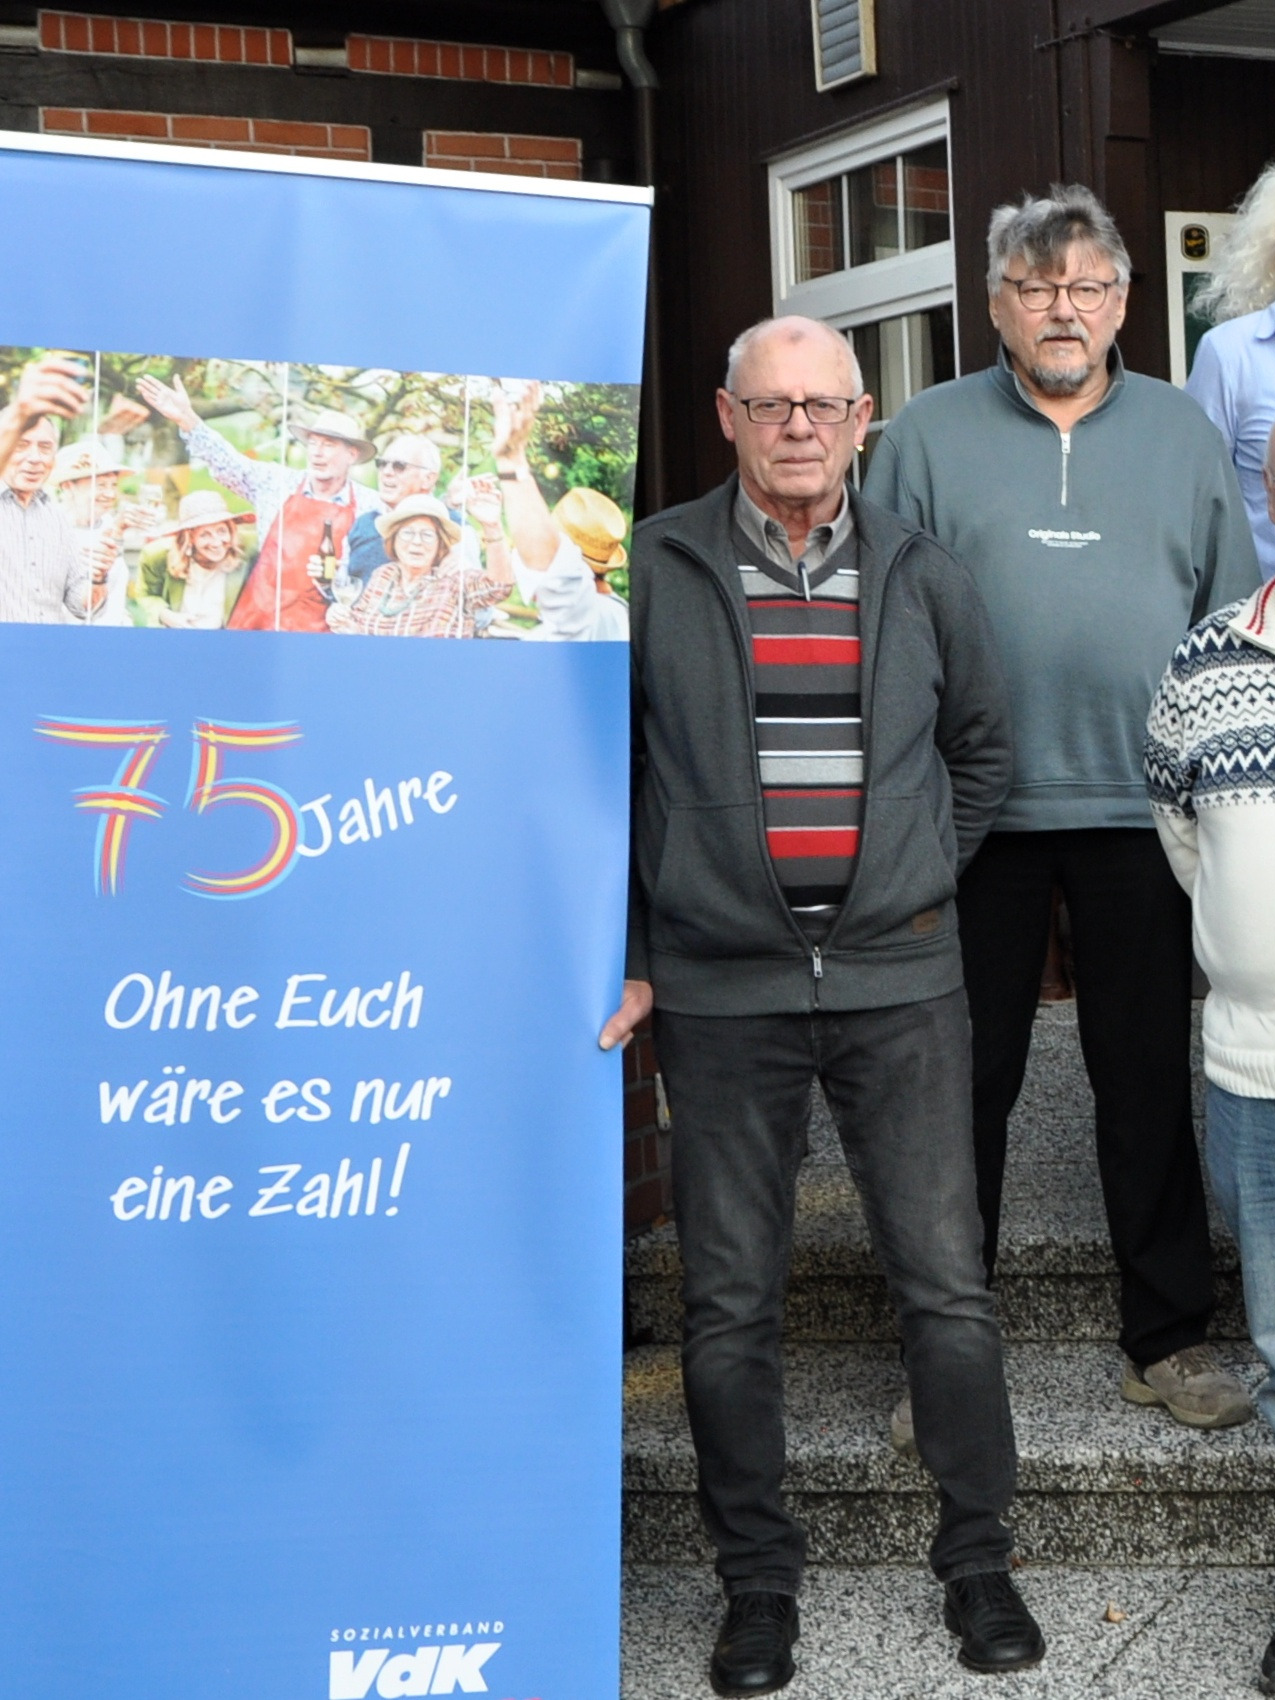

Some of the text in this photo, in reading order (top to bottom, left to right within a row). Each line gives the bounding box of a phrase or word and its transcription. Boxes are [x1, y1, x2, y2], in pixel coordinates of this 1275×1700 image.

[33, 713, 459, 900] 75 Jahre
[104, 970, 424, 1032] Ohne Euch
[99, 1065, 452, 1126] wäre es nur
[110, 1142, 411, 1222] eine Zahl!
[330, 1621, 505, 1643] SOZIALVERBAND
[329, 1642, 502, 1700] VdK
